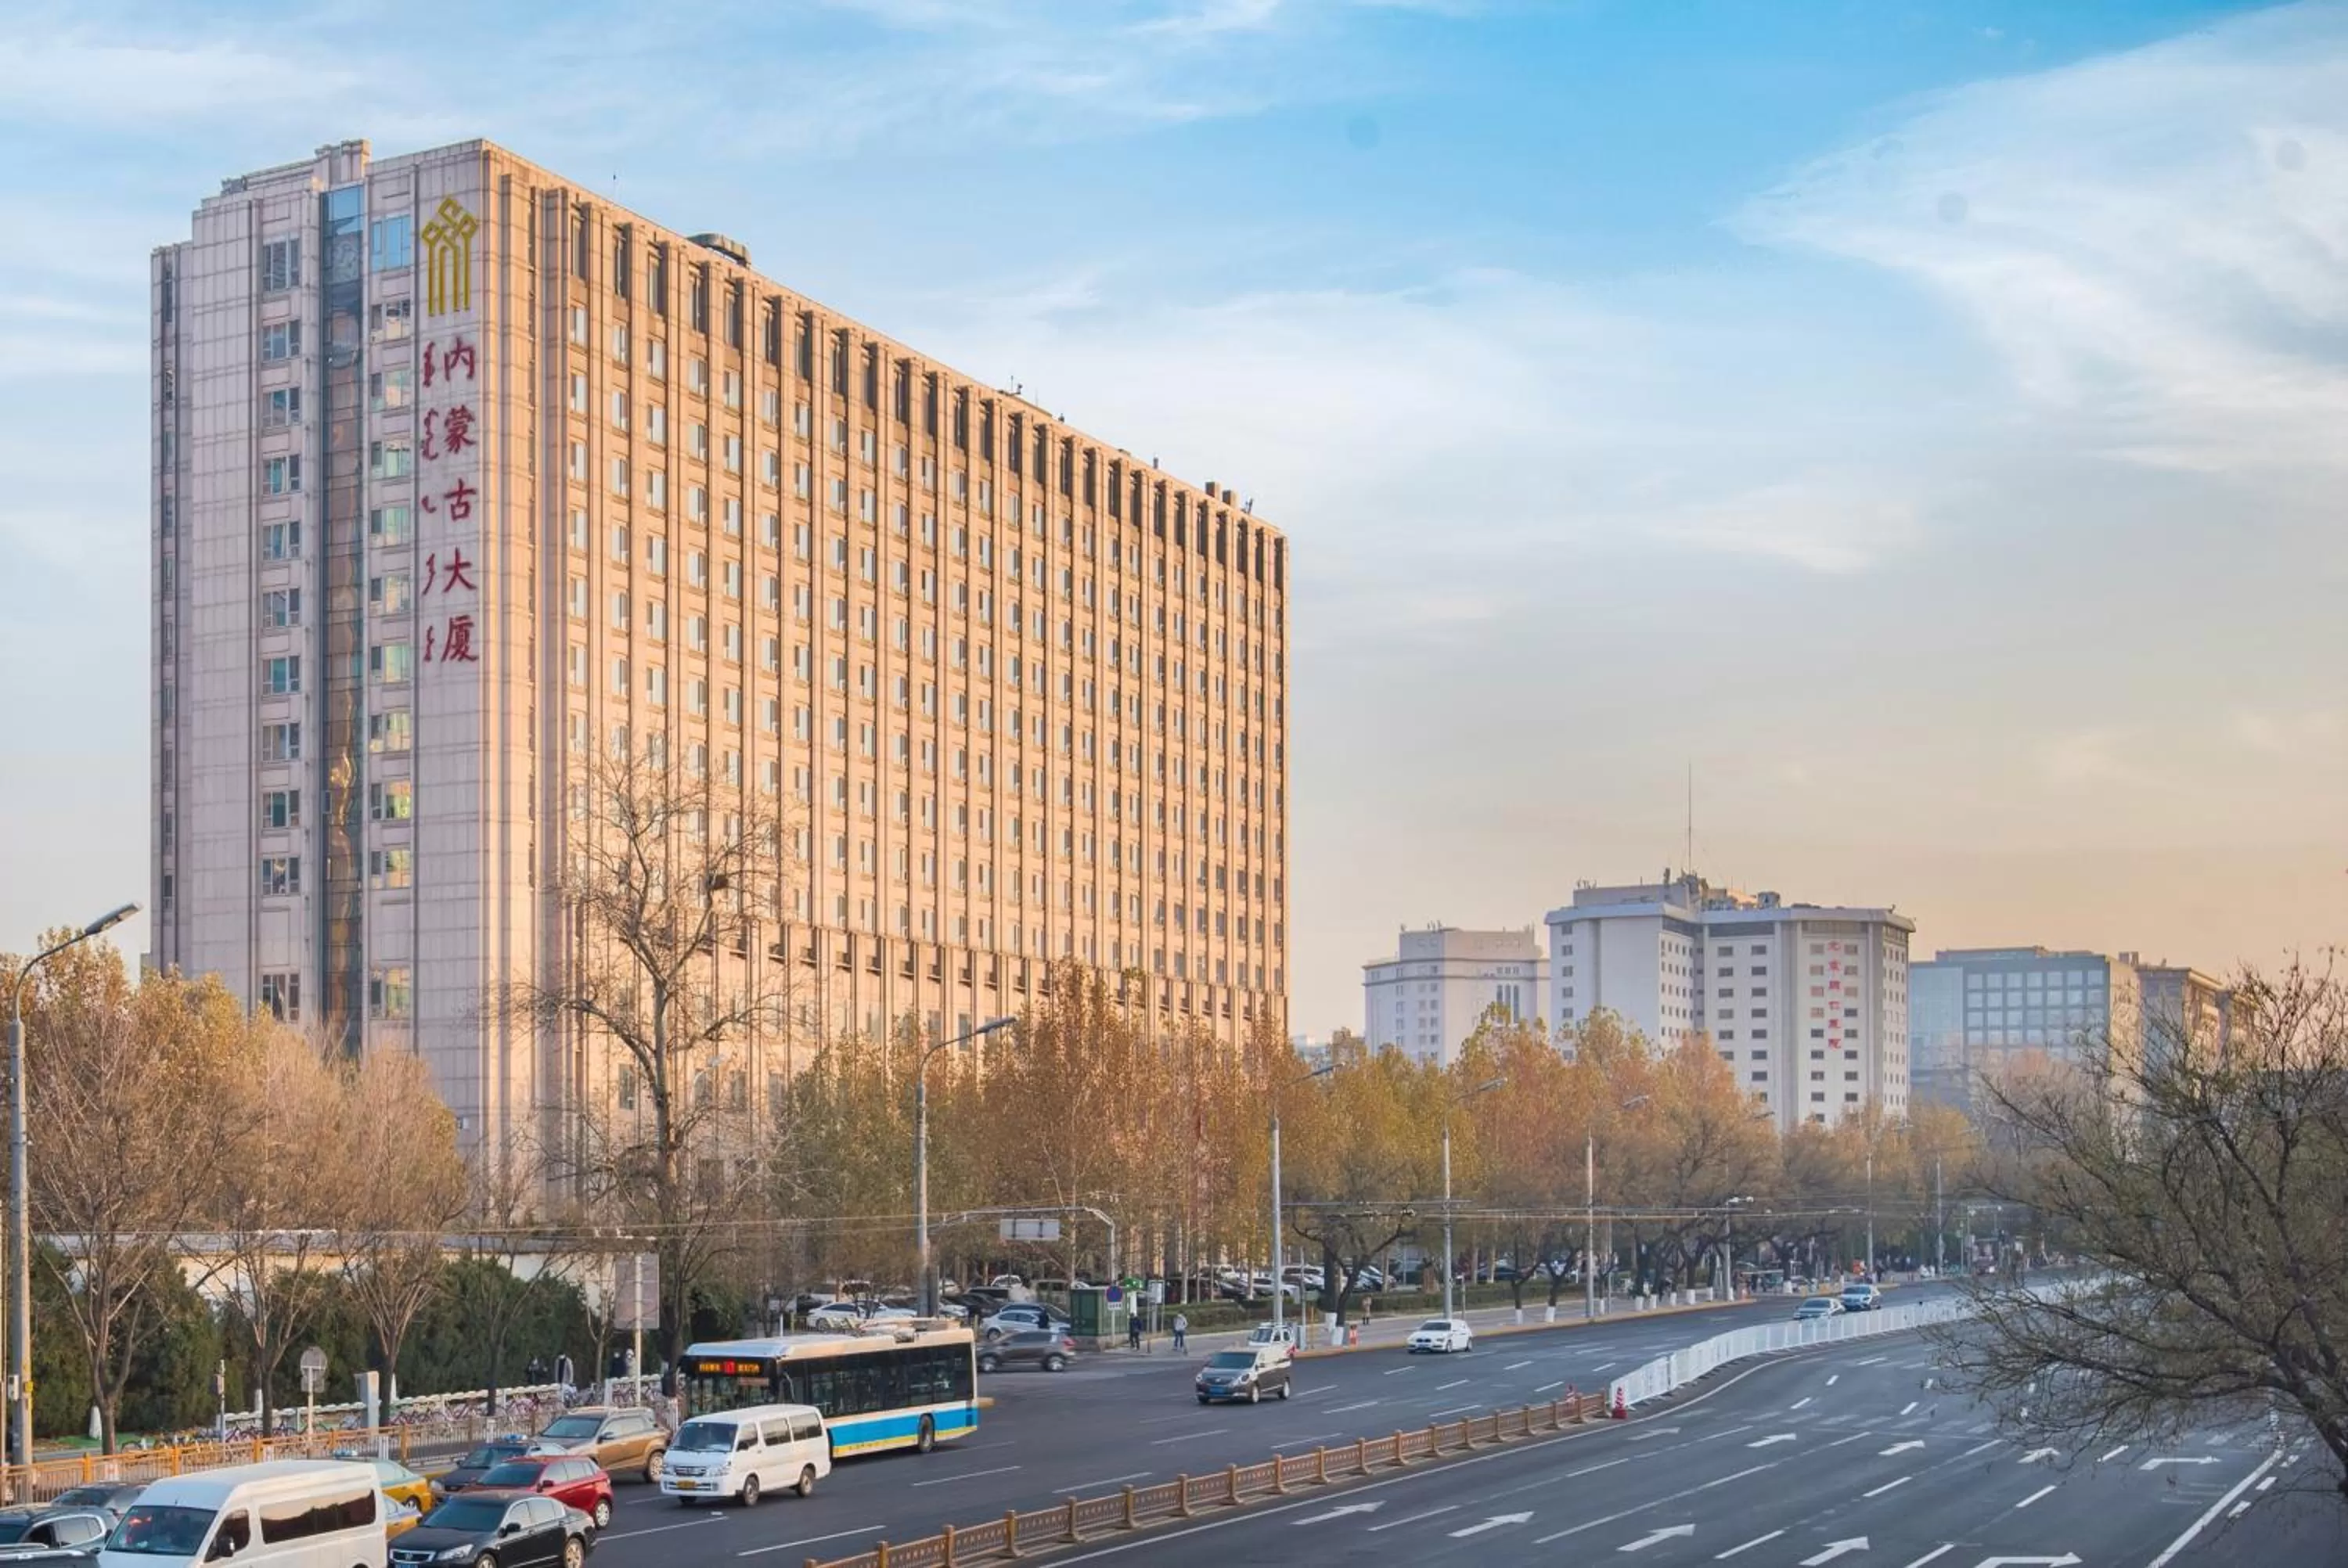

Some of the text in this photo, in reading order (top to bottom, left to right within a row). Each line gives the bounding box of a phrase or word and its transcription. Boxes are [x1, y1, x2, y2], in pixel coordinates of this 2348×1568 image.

[441, 336, 479, 662] 内蒙古大厦
